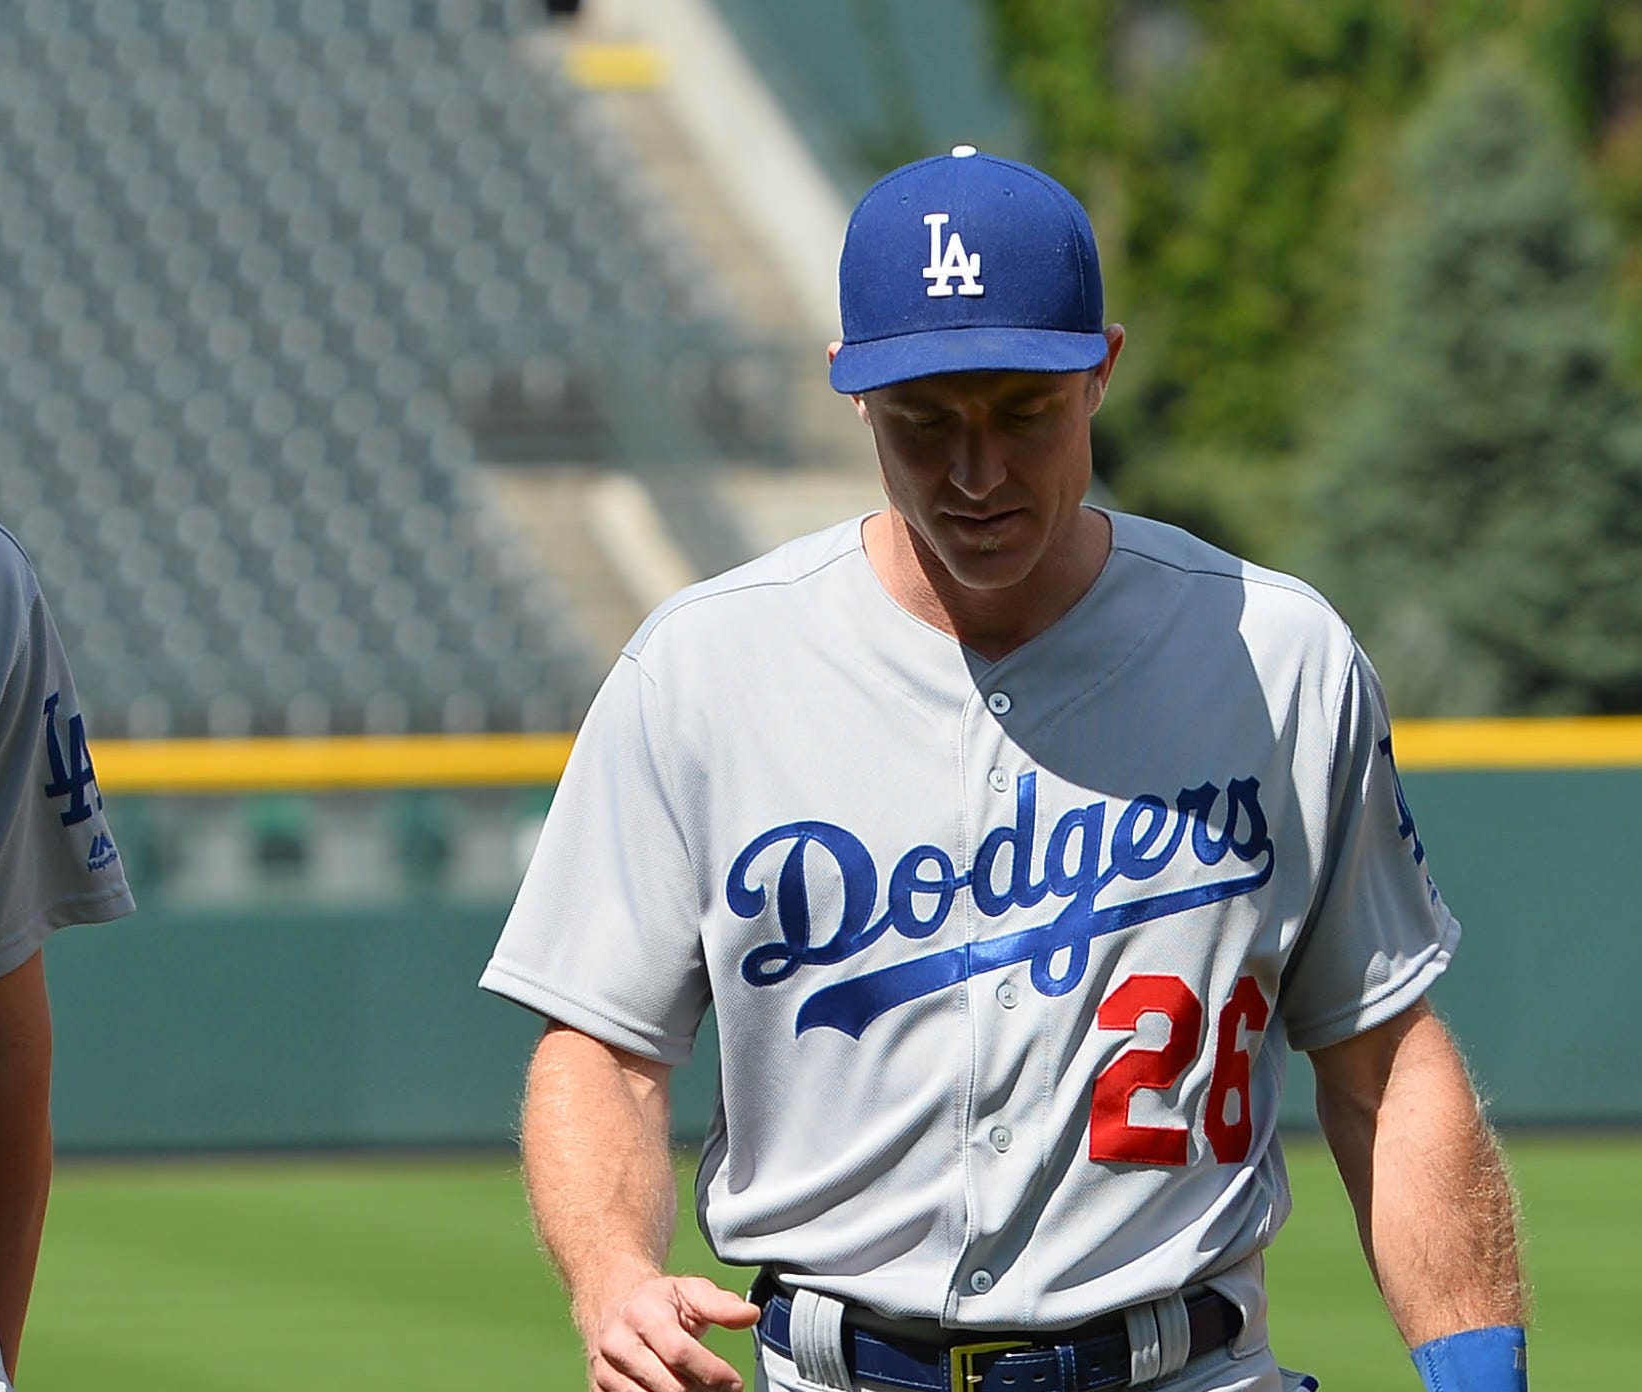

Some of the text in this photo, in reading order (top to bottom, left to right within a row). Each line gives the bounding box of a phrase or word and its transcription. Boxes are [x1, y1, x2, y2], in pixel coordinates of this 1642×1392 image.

[922, 212, 985, 297] LA
[726, 770, 1275, 998] Dodgers
[1088, 974, 1269, 1166] 26
